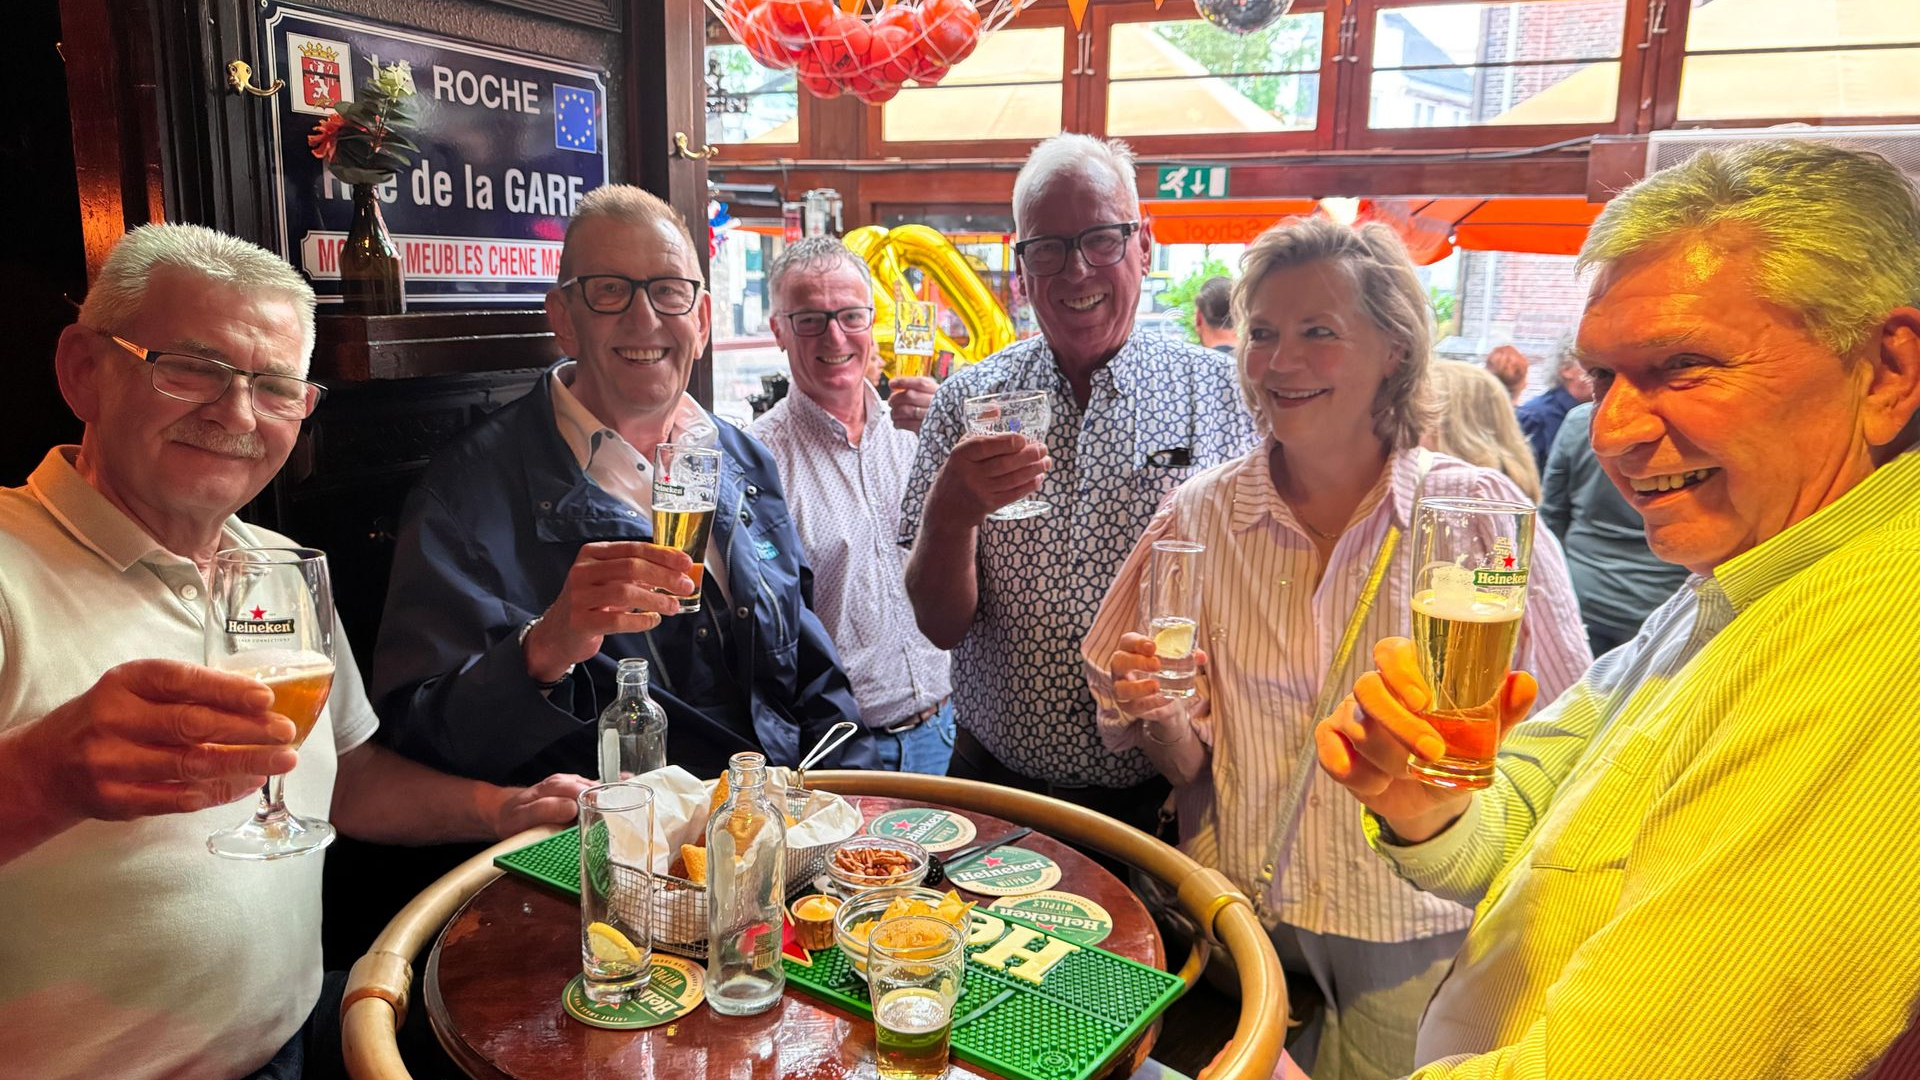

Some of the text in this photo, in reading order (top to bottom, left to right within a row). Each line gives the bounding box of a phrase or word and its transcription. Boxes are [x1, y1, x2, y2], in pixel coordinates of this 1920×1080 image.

[433, 65, 541, 114] ROCHE
[412, 159, 452, 207] de
[464, 164, 494, 210] la
[505, 168, 583, 218] GARE
[406, 242, 483, 276] MEUBLES
[488, 245, 536, 277] CHENE
[228, 620, 291, 633] Heineken
[957, 860, 1047, 881] Heineken
[1033, 900, 1074, 912] WITPILS
[999, 907, 1100, 931] Heineken
